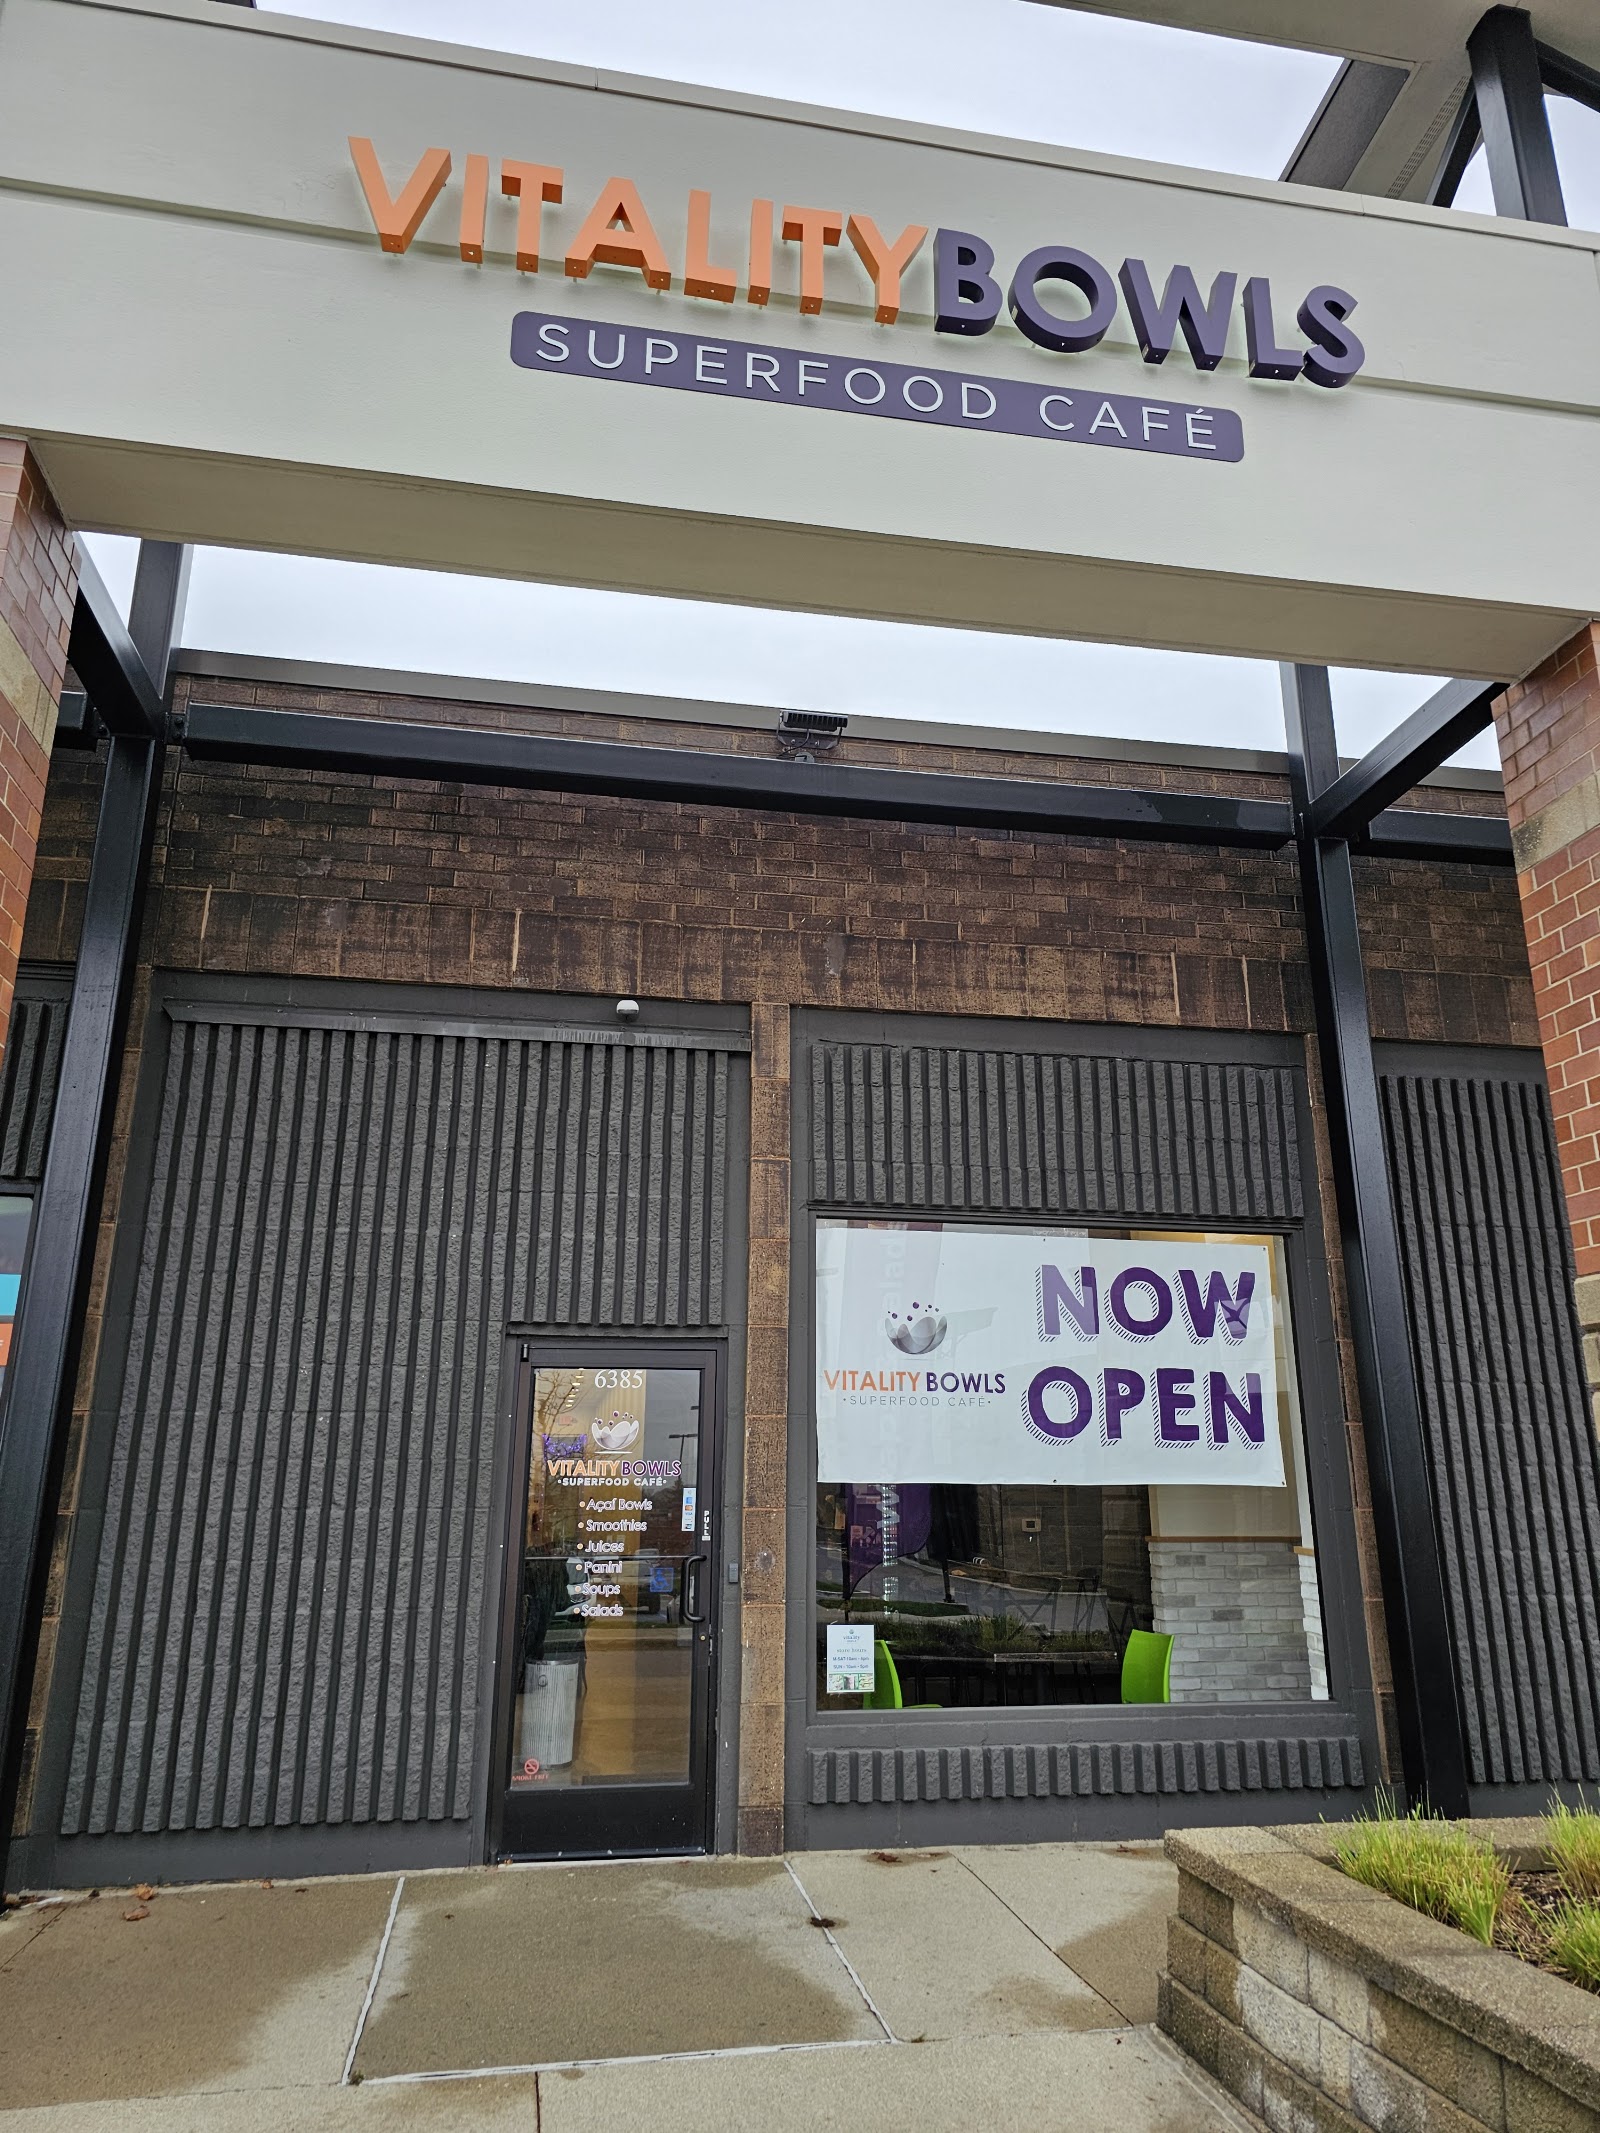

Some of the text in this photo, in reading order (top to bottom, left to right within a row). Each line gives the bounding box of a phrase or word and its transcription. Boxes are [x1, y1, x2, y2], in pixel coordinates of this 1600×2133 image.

[347, 136, 1365, 388] VITALITY BOWLS
[535, 322, 1217, 450] SUPERFOOD CAFÉ
[1035, 1264, 1256, 1346] NOW
[594, 1369, 643, 1389] 6385
[823, 1369, 1006, 1394] VITALITY BOWLS
[849, 1395, 986, 1408] SUPERFOOD CAFÉ
[1021, 1366, 1266, 1451] OPEN
[547, 1460, 682, 1477] VITALITY BOWLS
[562, 1476, 663, 1487] SUPERFOOD CAFÉ
[618, 1498, 653, 1511] Bowls
[585, 1519, 648, 1532] Smoothies
[585, 1540, 625, 1553] Juices
[584, 1561, 623, 1574] Panini
[582, 1582, 621, 1598] Soups
[581, 1603, 624, 1617] Salads
